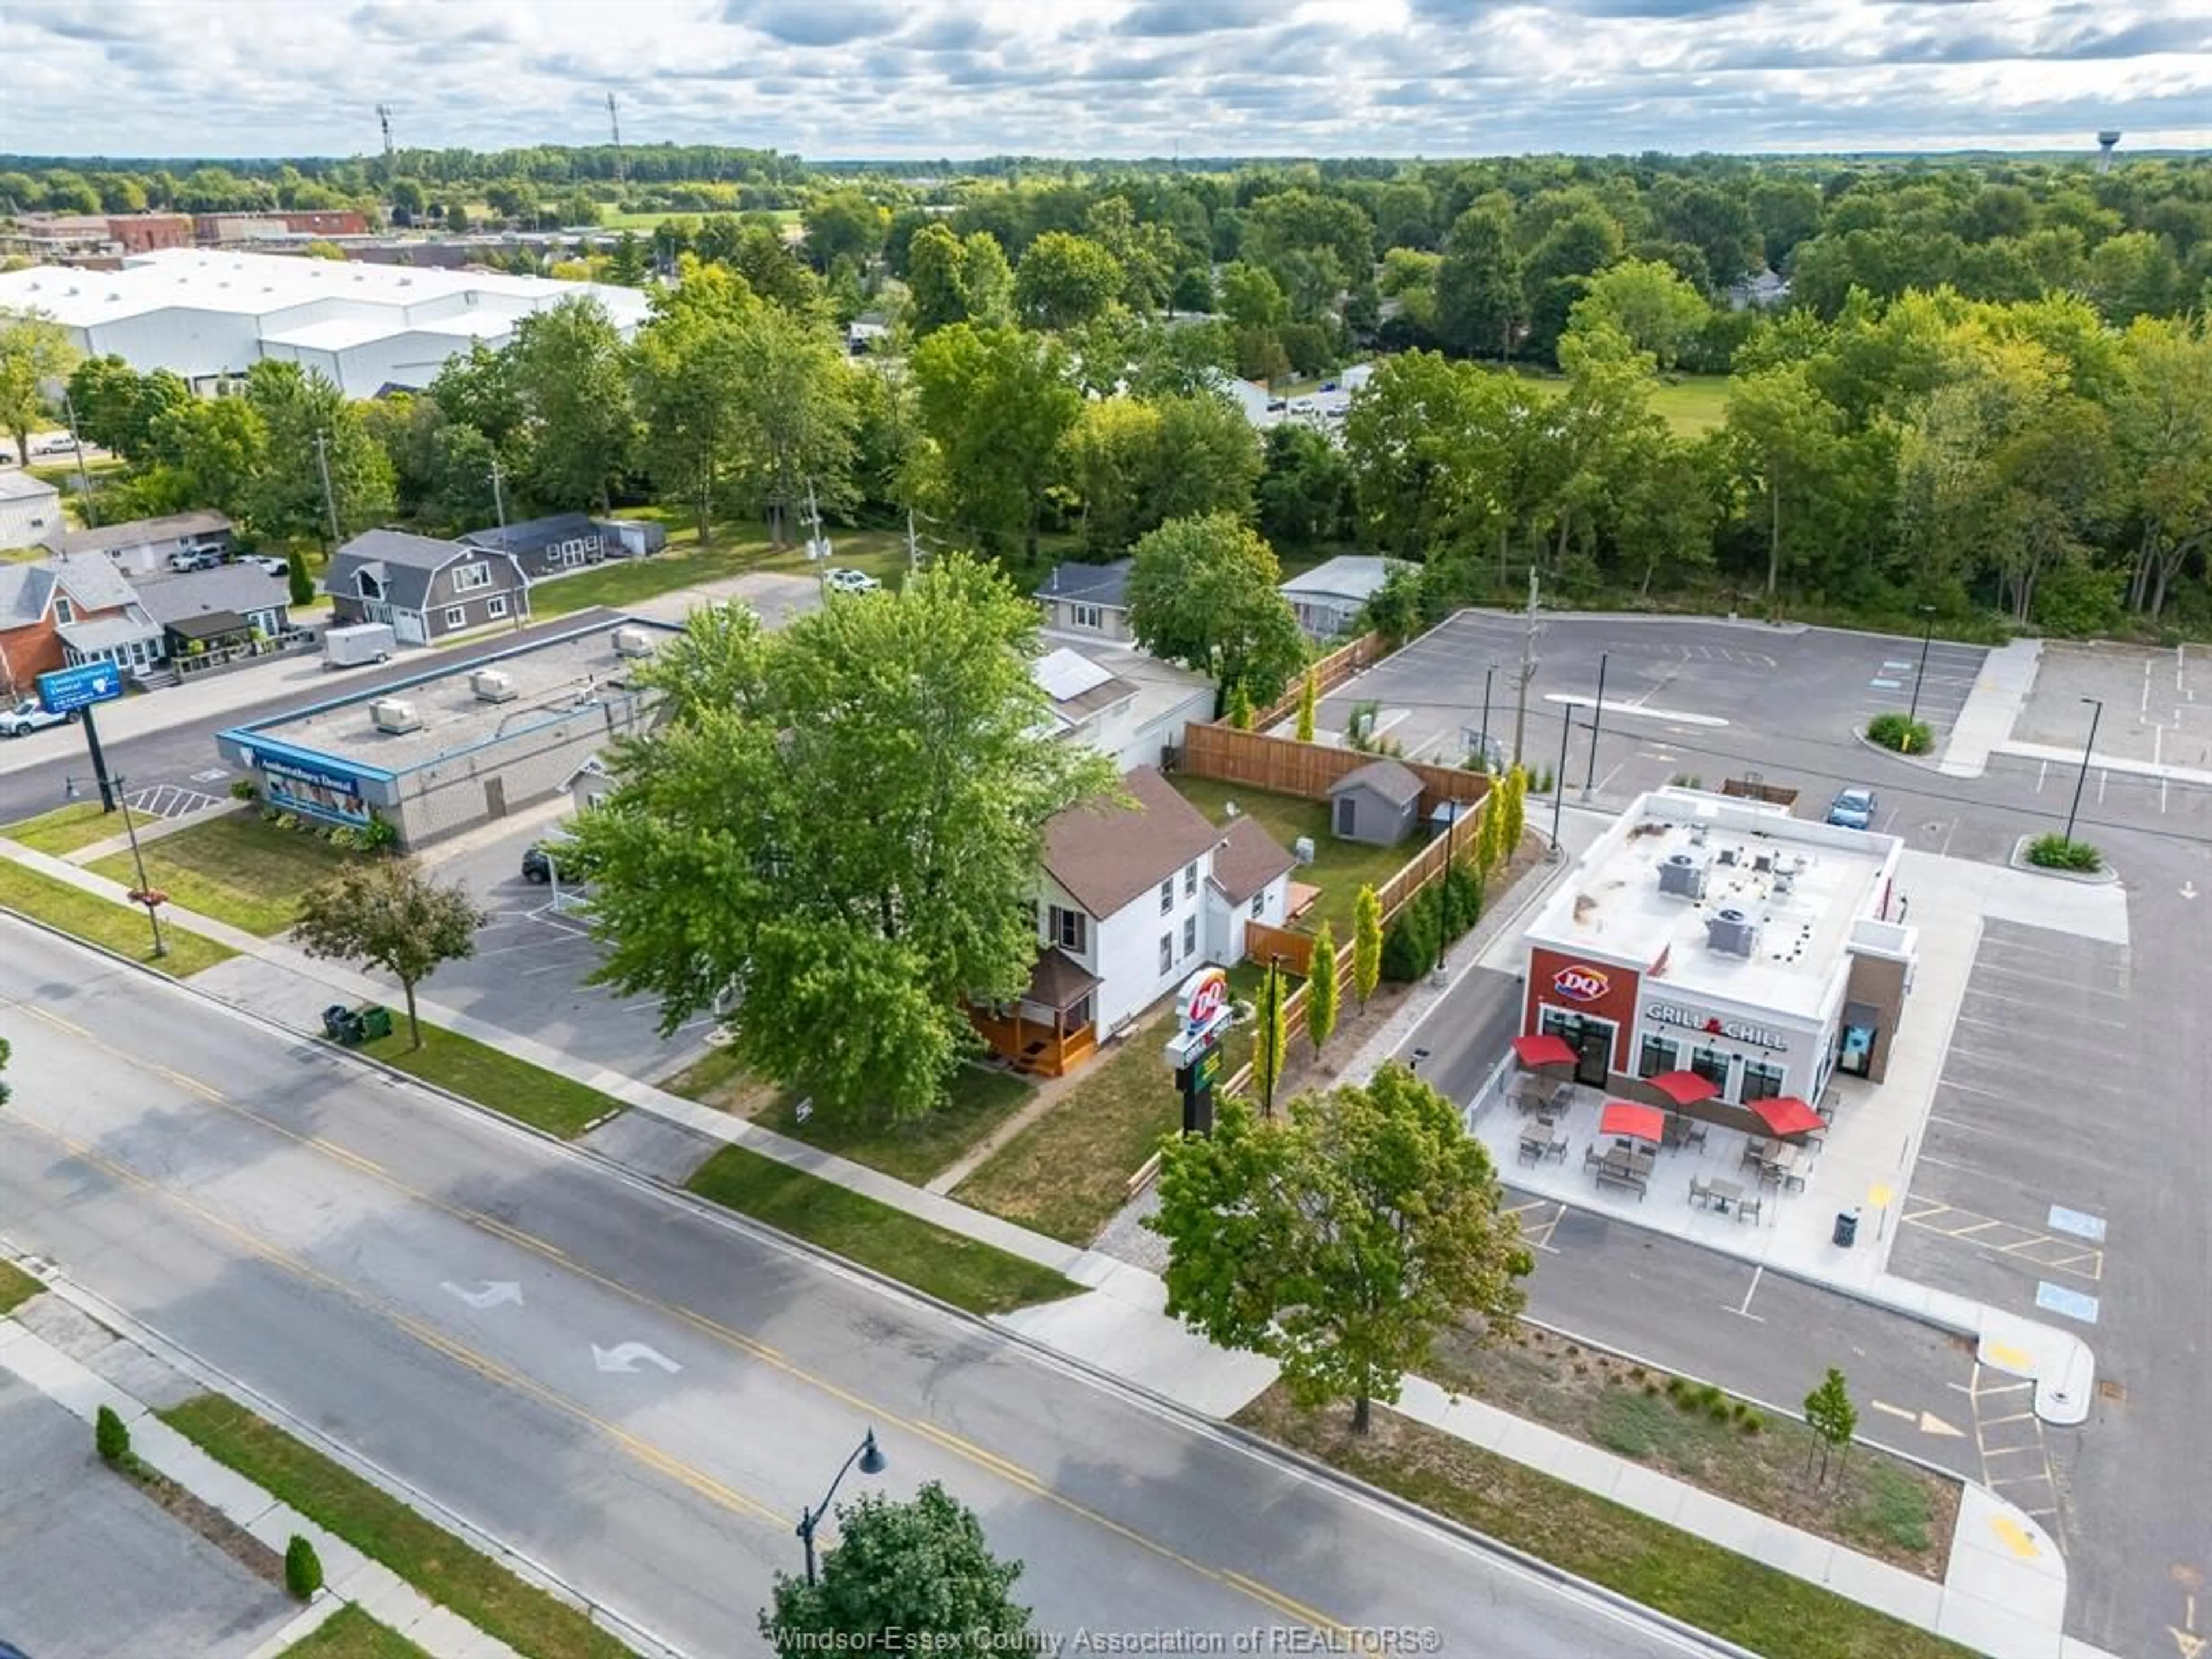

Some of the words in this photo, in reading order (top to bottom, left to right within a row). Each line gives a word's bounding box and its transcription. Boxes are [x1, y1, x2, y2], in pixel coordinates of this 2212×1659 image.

[1564, 972, 1600, 997] DQ
[1646, 1003, 1705, 1030] GRILL
[1725, 1022, 1787, 1052] CHILL
